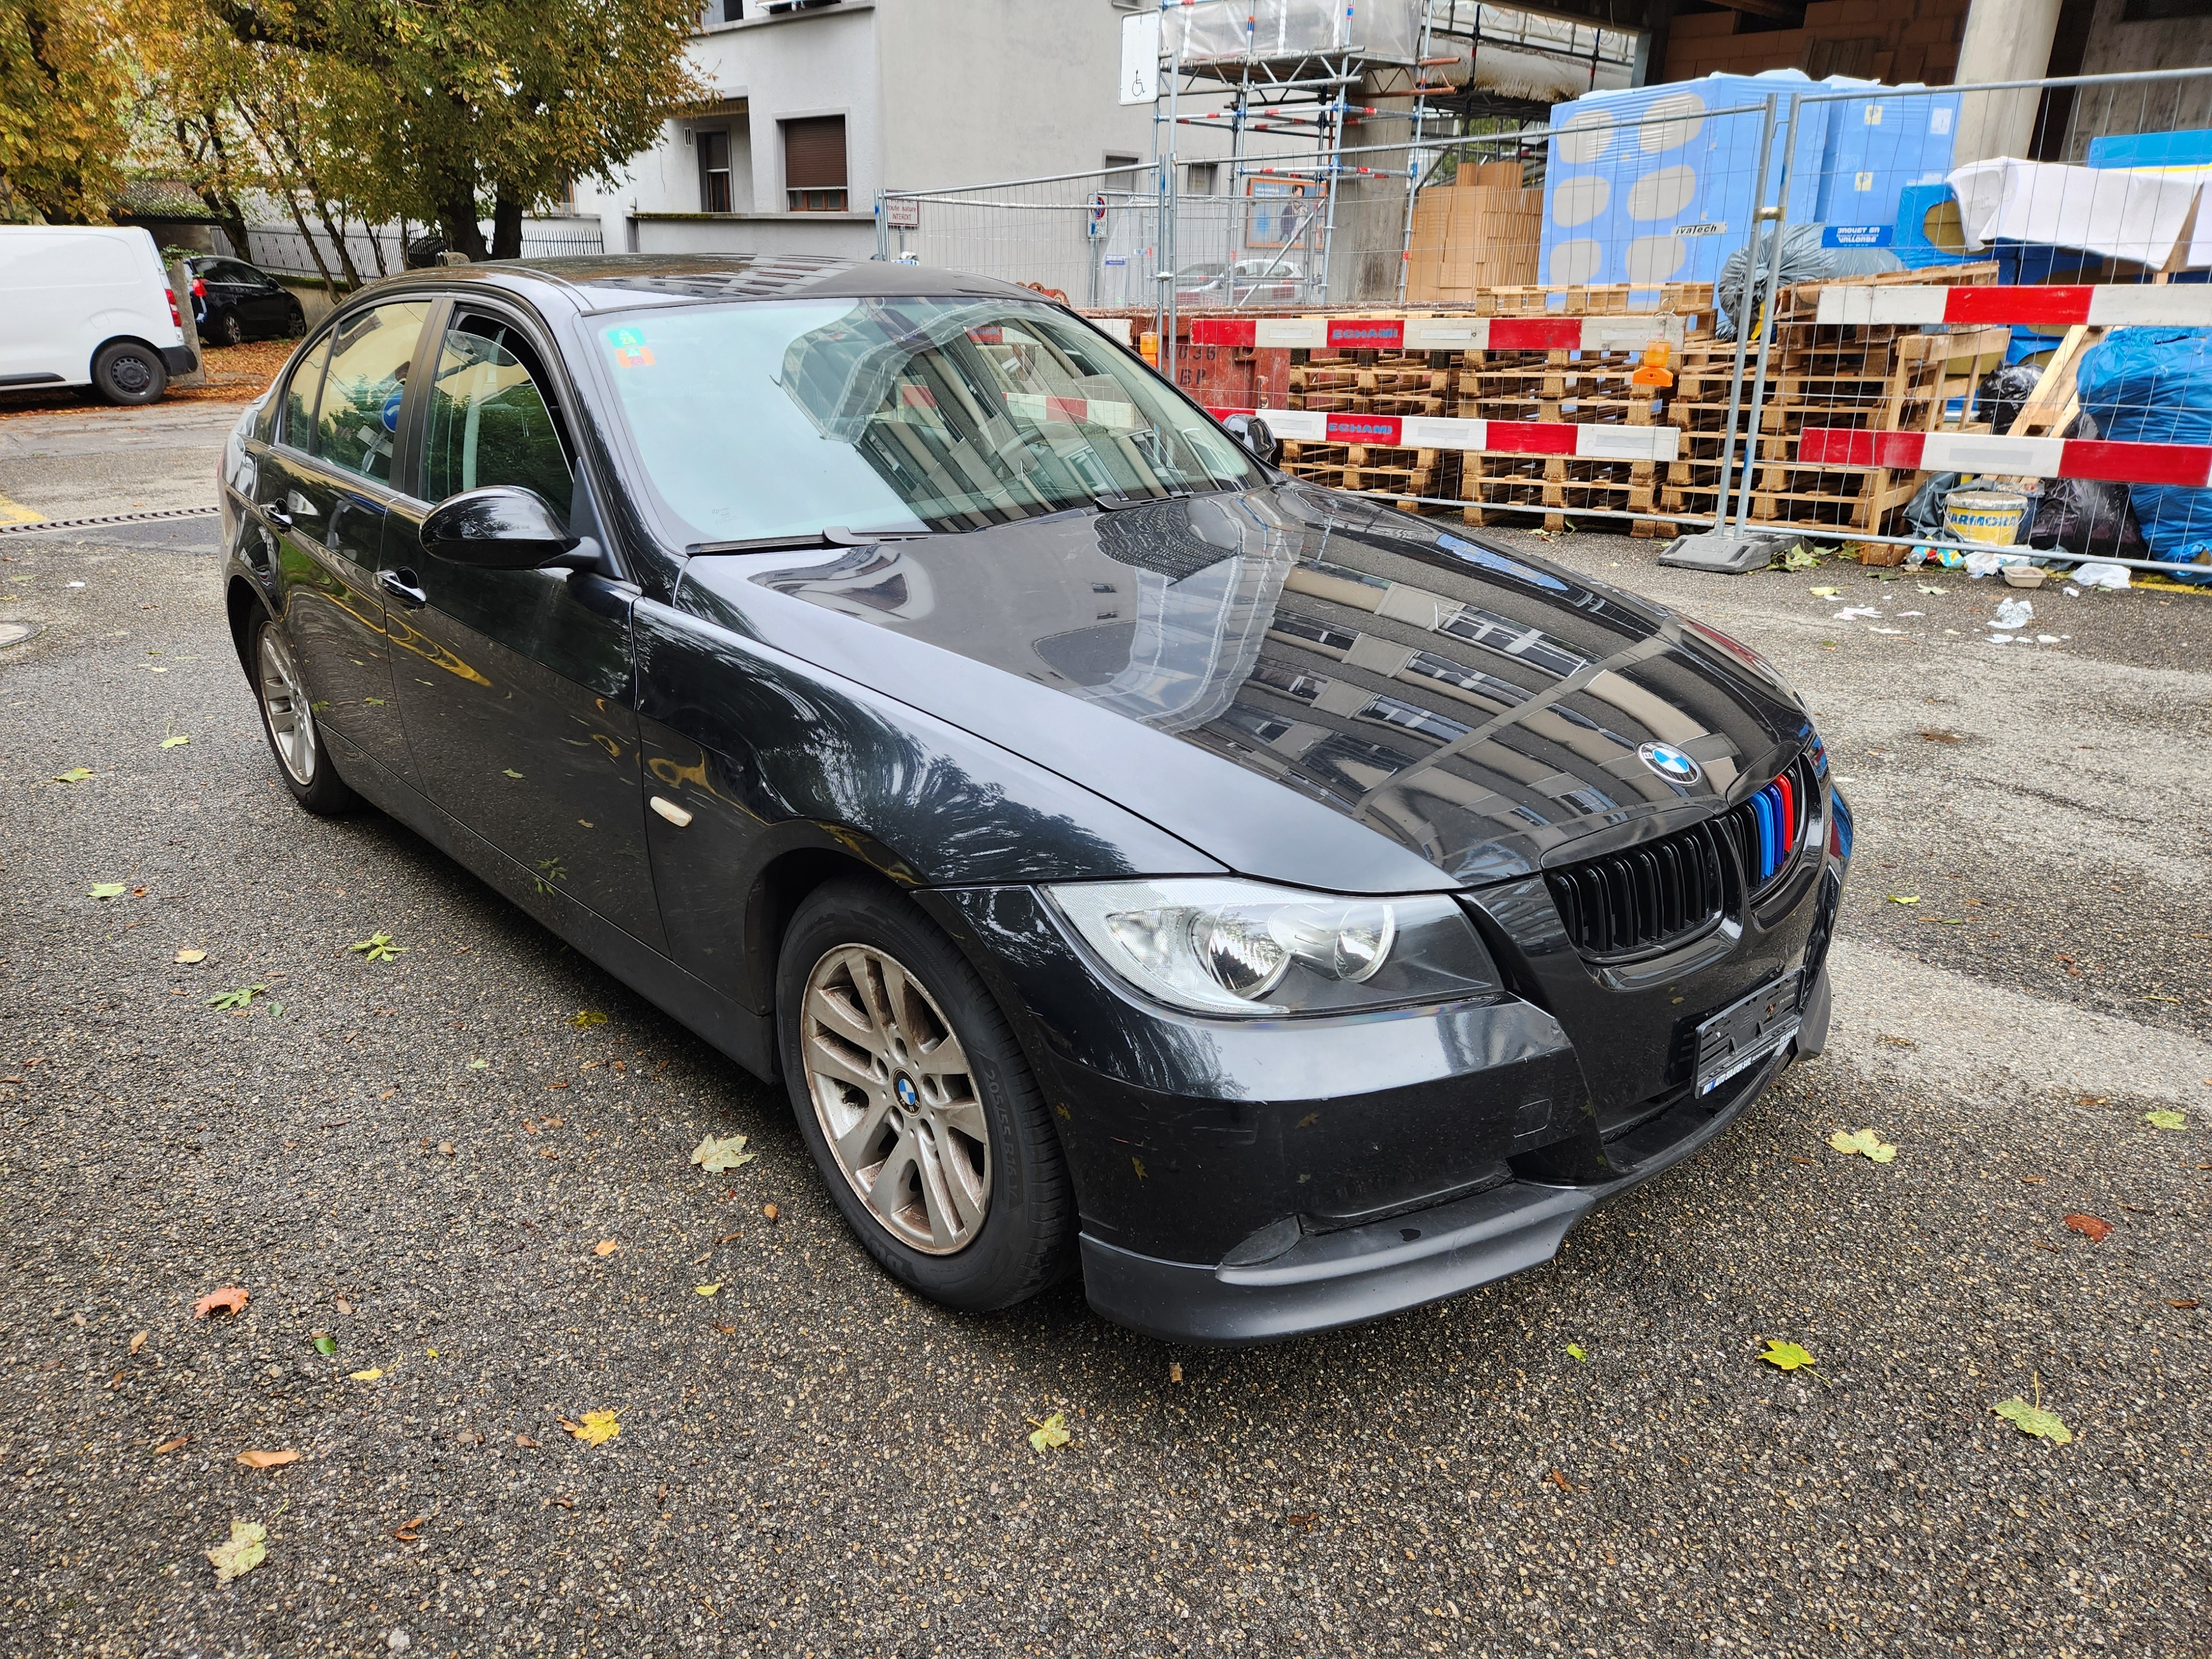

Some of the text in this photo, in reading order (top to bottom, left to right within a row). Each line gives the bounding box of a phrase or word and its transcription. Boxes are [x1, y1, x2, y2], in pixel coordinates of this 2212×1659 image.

[1332, 328, 1399, 339] ECHAMI
[1328, 422, 1392, 435] ECHAMI
[899, 1098, 920, 1112] BMW
[985, 1069, 1012, 1136] 205/55
